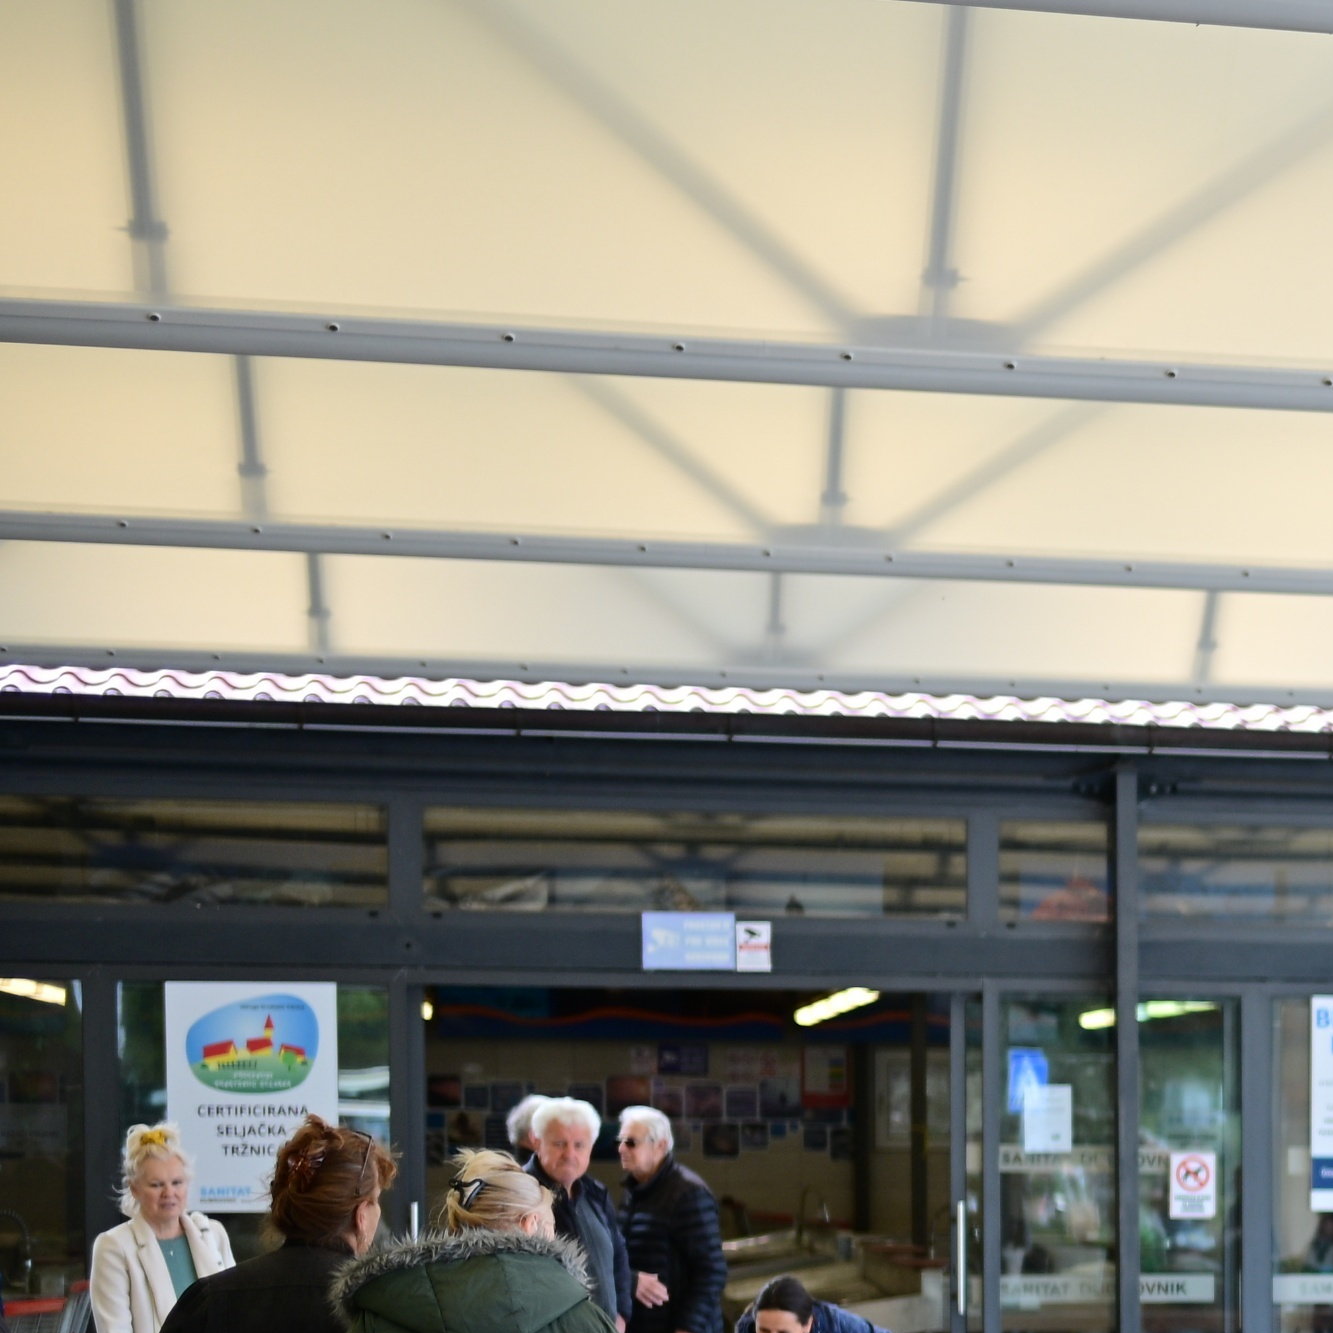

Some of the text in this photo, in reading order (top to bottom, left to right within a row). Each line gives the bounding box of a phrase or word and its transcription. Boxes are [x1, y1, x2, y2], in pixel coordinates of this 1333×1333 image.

[197, 1104, 309, 1118] CERTIFICIRANA
[216, 1121, 287, 1139] SELJAČKA
[222, 1142, 278, 1156] TRŽNIC
